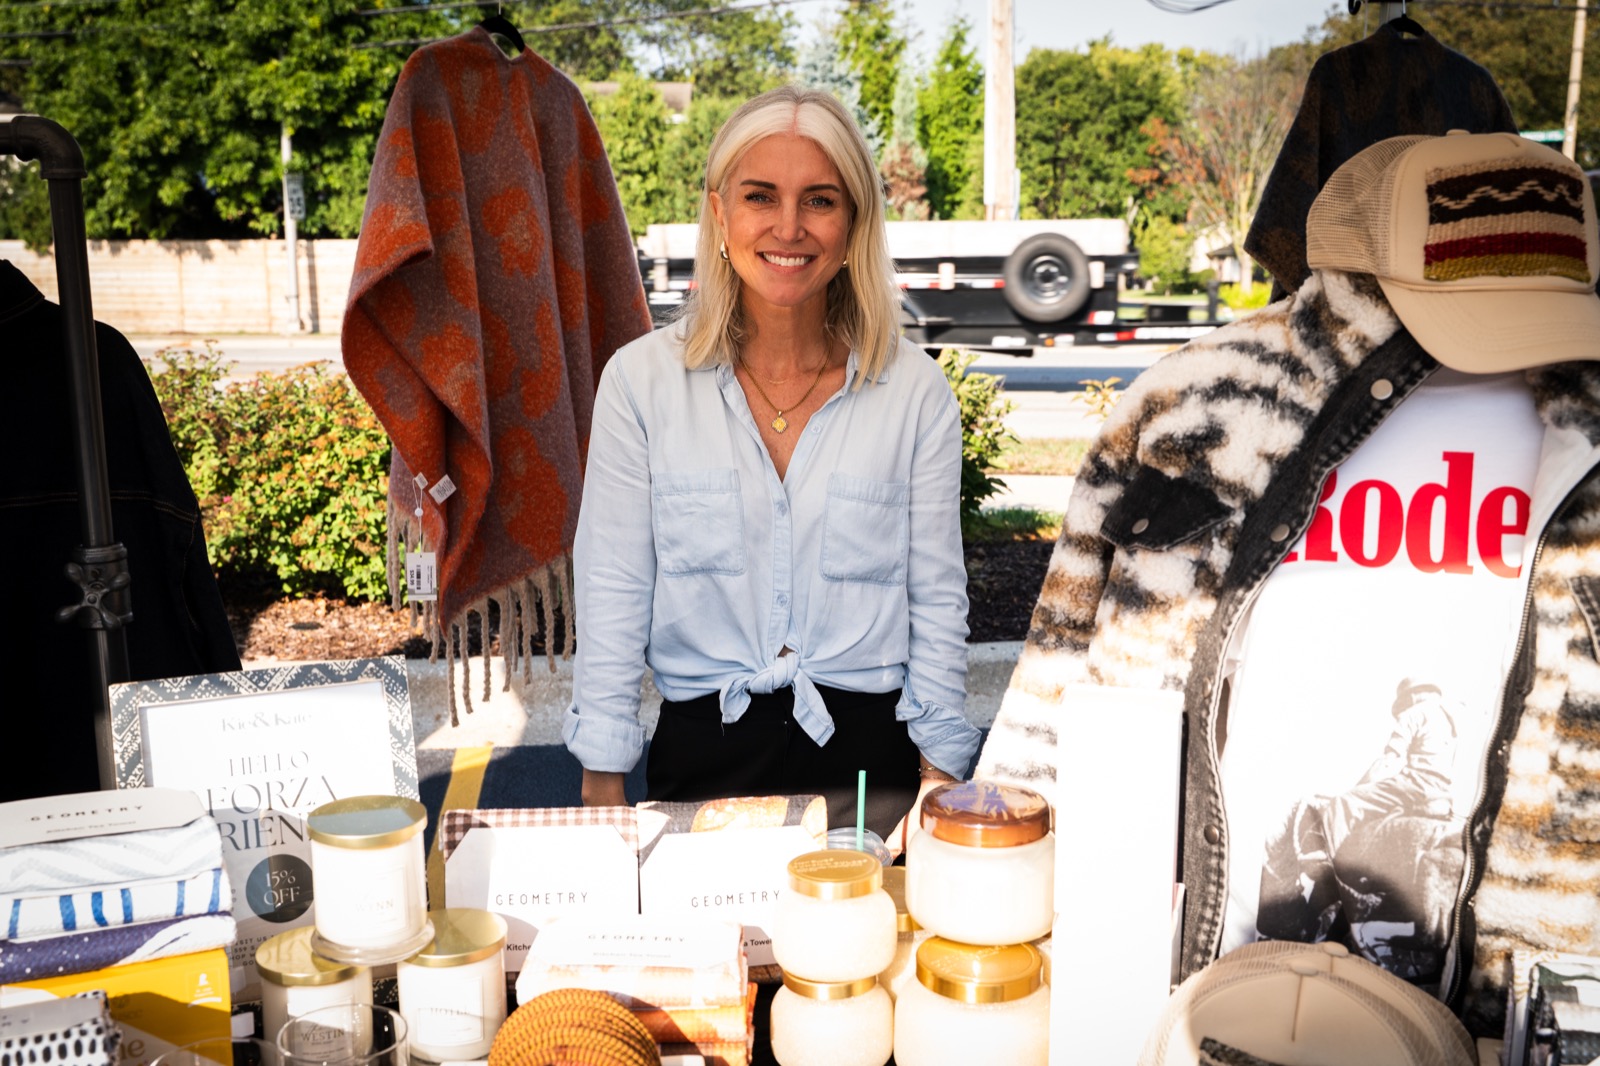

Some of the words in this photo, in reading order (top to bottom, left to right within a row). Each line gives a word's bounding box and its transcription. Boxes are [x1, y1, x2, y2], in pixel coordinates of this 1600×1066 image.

[31, 805, 143, 821] GEOMETRY
[217, 814, 312, 851] RIEN
[266, 869, 296, 888] 15%
[263, 886, 300, 907] OFF
[495, 891, 588, 906] GEOMETRY
[691, 890, 780, 908] GEOMETRY
[588, 934, 685, 943] GEOMETRY
[506, 943, 532, 951] Kitche
[301, 1028, 345, 1042] WESTIN
